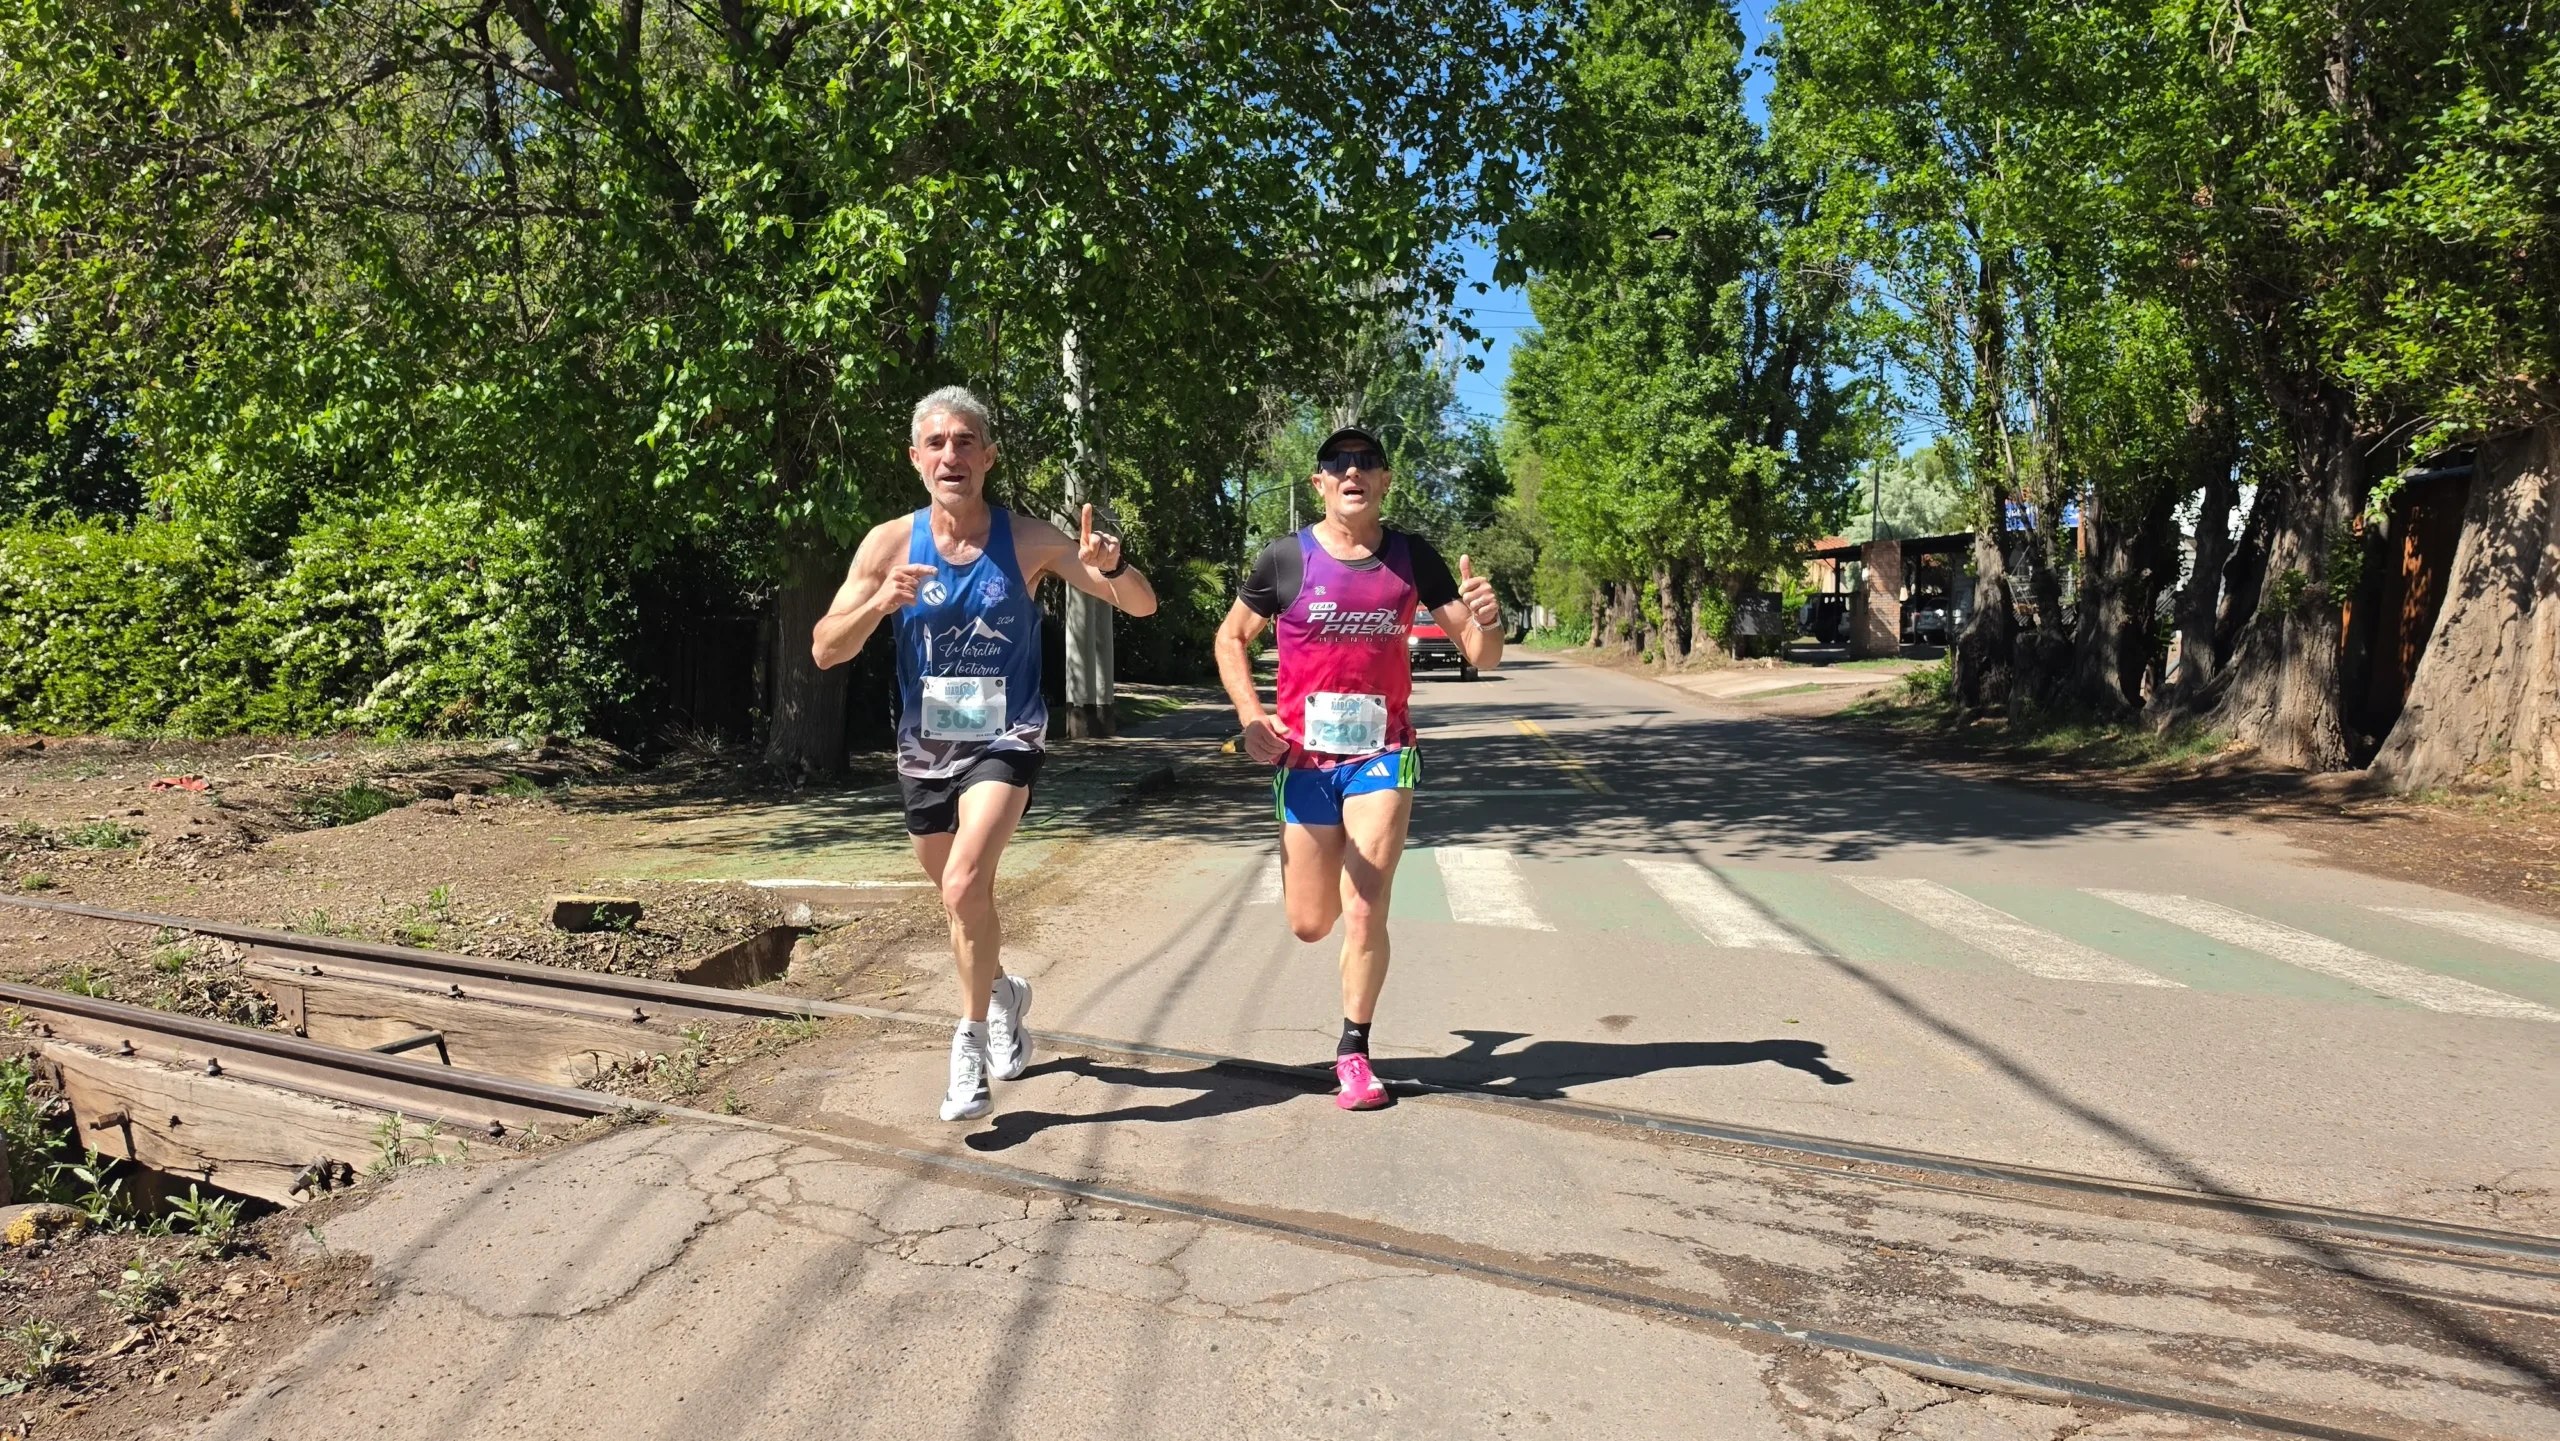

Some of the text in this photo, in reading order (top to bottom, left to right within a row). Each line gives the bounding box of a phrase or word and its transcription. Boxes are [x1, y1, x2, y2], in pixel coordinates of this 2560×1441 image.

[996, 616, 1015, 625] 2024
[1307, 612, 1387, 623] PURA
[939, 660, 1000, 677] Nocturna
[937, 709, 987, 729] 305
[1322, 723, 1368, 743] 320
